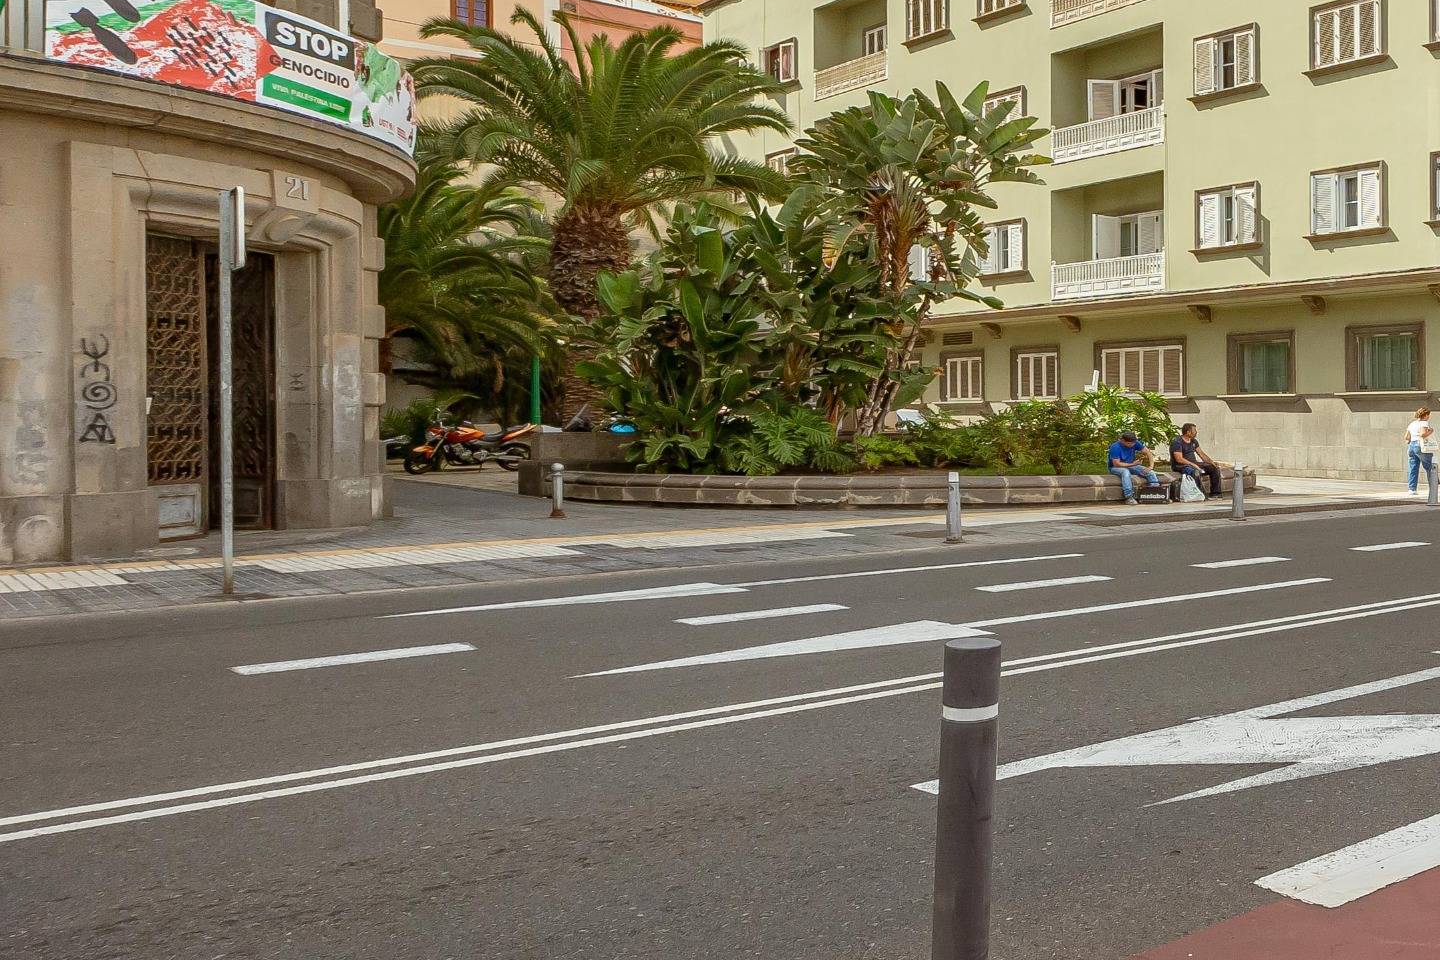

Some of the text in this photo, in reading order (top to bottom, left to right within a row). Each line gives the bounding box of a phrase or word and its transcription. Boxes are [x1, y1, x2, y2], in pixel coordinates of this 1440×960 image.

[275, 21, 348, 61] STOP
[269, 54, 350, 89] GENOCIDIO
[285, 176, 309, 200] 21
